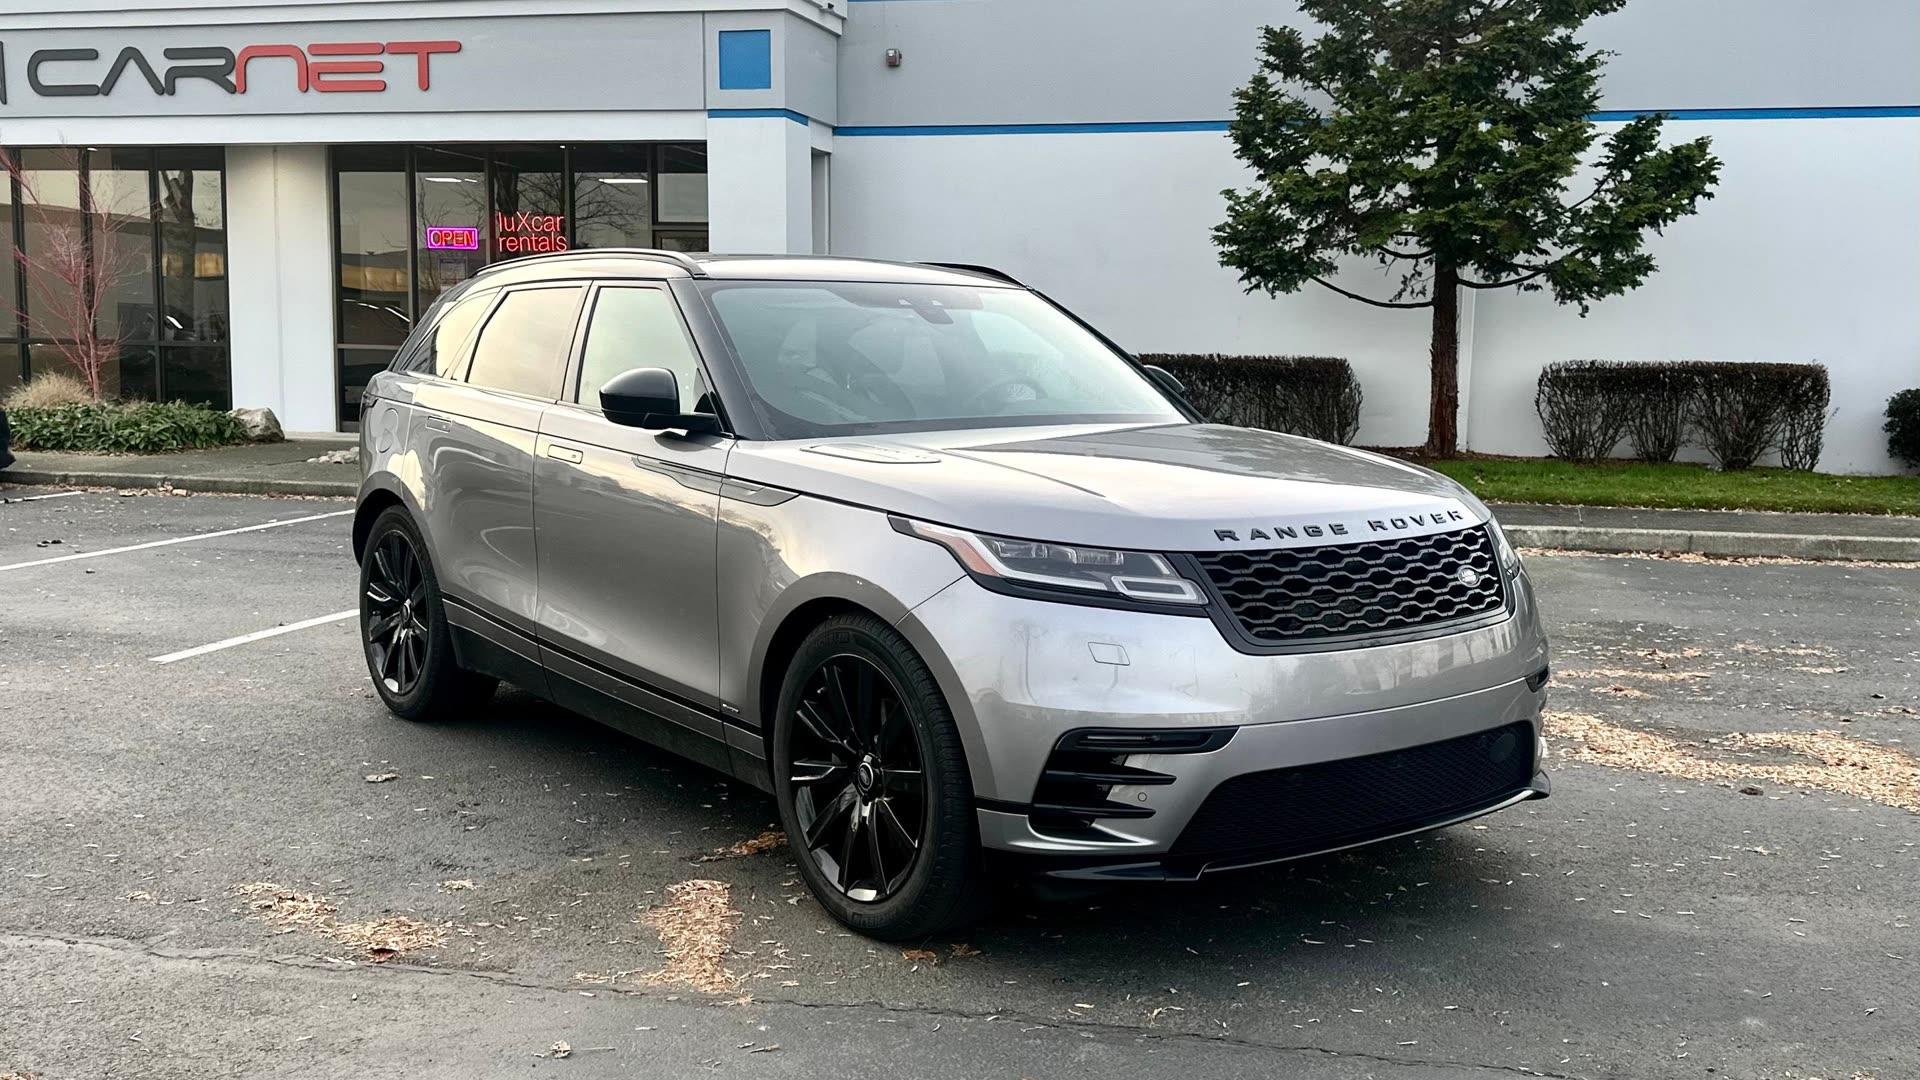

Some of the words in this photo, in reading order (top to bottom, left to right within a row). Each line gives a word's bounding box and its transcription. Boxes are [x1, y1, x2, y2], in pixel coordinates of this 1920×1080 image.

[498, 211, 565, 232] luXcar
[430, 230, 475, 247] OPEN
[498, 232, 568, 252] rentals
[1214, 522, 1349, 542] RANGE
[1367, 509, 1464, 532] ROVER
